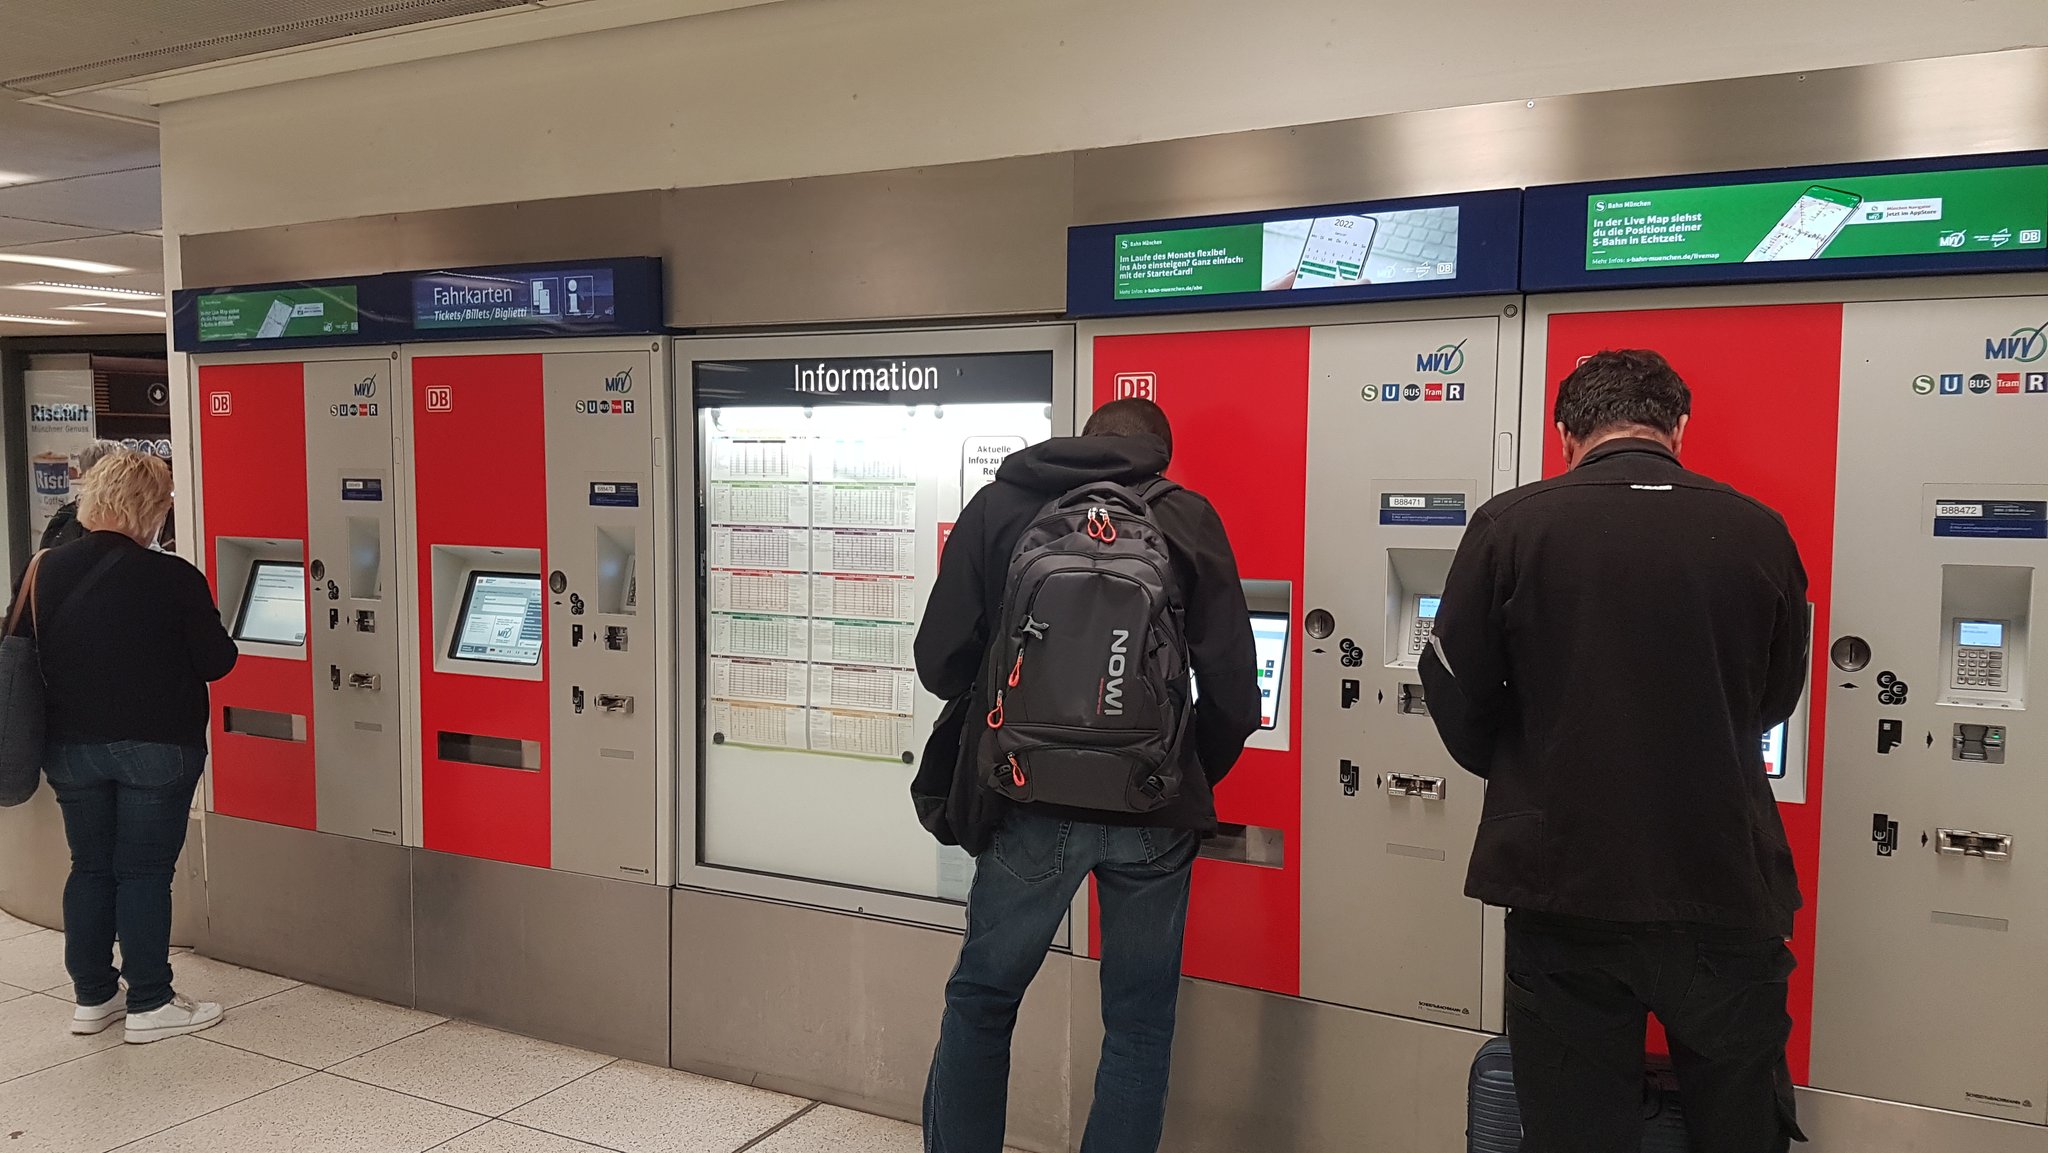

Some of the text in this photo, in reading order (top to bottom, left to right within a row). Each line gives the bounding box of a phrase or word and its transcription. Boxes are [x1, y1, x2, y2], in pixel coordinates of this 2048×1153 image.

[1334, 218, 1354, 229] 2022
[1593, 213, 1702, 228] In der Live Map siehst
[1593, 223, 1702, 237] du die Position deiner
[2021, 231, 2039, 241] DB
[1592, 234, 1685, 247] S-Bahn in Echtzeit.
[1131, 254, 1151, 263] Laufe
[1153, 252, 1166, 261] des
[1167, 251, 1195, 260] Monats
[1197, 248, 1226, 258] flexibel
[1626, 252, 1719, 263] s-bahn-muenchen.de/livemap
[1120, 256, 1244, 272] ins Abo einsteigen? Ganz einfach:
[1120, 268, 1193, 279] mit der StarterCard!
[434, 286, 513, 305] Fahrkarten
[434, 307, 527, 322] Tickets/Billets/Biglietti
[794, 362, 938, 391] Information
[1119, 377, 1151, 399] DB
[1914, 375, 2044, 394] S U BUS Tram R
[428, 388, 449, 409] DB
[1362, 385, 1461, 400] S U BUS Tram R
[212, 395, 230, 412] DB
[331, 405, 337, 416] S
[341, 405, 347, 415] U
[370, 405, 377, 415] R
[576, 401, 585, 412] S
[589, 402, 597, 412] U
[625, 401, 633, 413] R
[968, 456, 988, 464] Infos
[1393, 498, 1420, 506] B88471
[1941, 506, 1977, 515] B88472
[1104, 630, 1129, 715] NOWI
